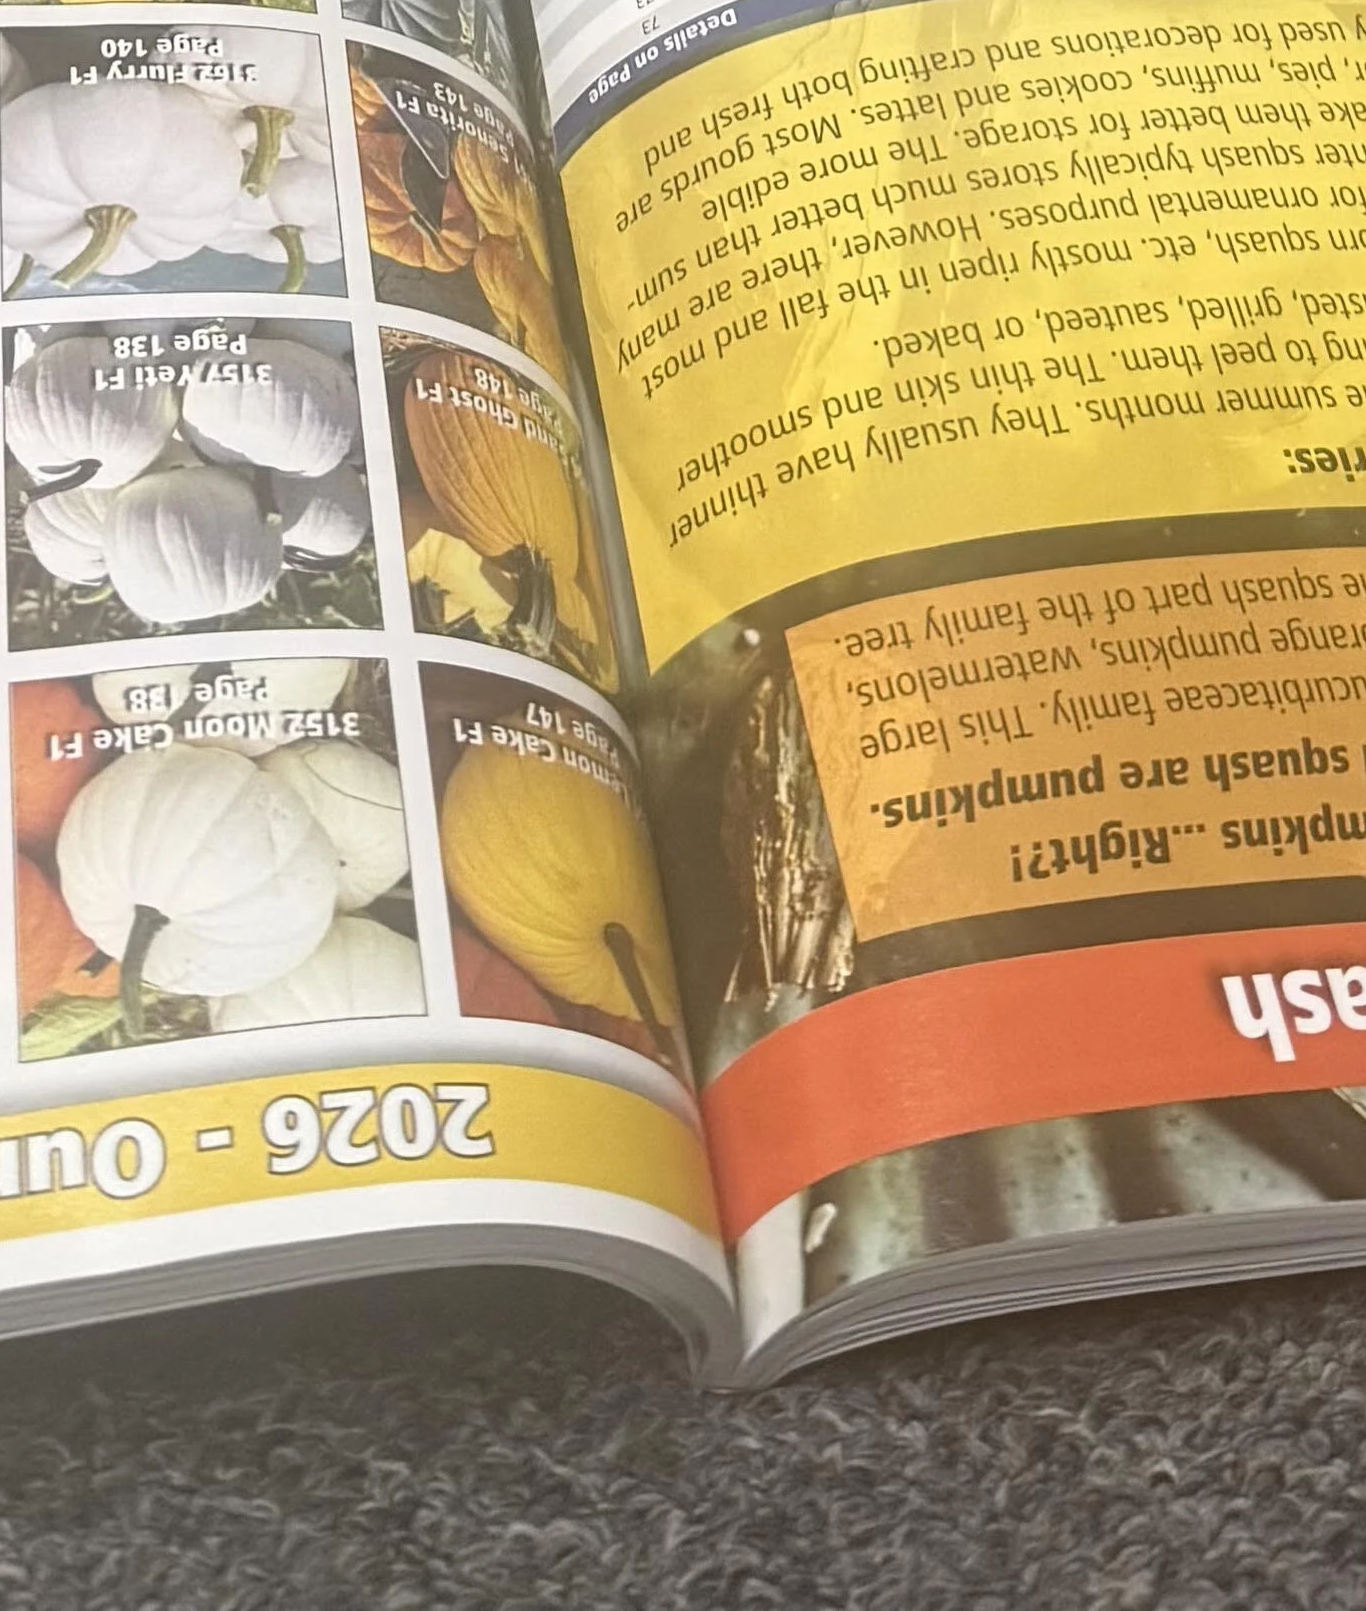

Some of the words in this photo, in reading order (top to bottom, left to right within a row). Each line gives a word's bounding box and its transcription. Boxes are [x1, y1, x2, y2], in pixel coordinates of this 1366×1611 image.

[641, 15, 660, 35] 73
[664, 9, 737, 51] Details
[635, 46, 659, 68] on
[589, 63, 631, 103] Page
[113, 335, 165, 359] 138
[173, 328, 247, 355] Page
[95, 367, 125, 391] F1
[135, 364, 193, 391] Yeti
[205, 363, 273, 389] 3157
[1075, 391, 1205, 430] months.
[1217, 385, 1337, 413] summer
[992, 402, 1070, 437] They
[866, 416, 979, 463] usually
[776, 441, 855, 484] have
[669, 473, 768, 548] thinner
[959, 705, 1034, 746] This
[1040, 689, 1156, 733] family.
[859, 718, 951, 759] large
[1120, 757, 1189, 789] are
[1204, 737, 1349, 792] squash
[870, 754, 1105, 828] pumpkins.
[197, 1127, 231, 1151] -
[263, 1083, 495, 1175] 2026
